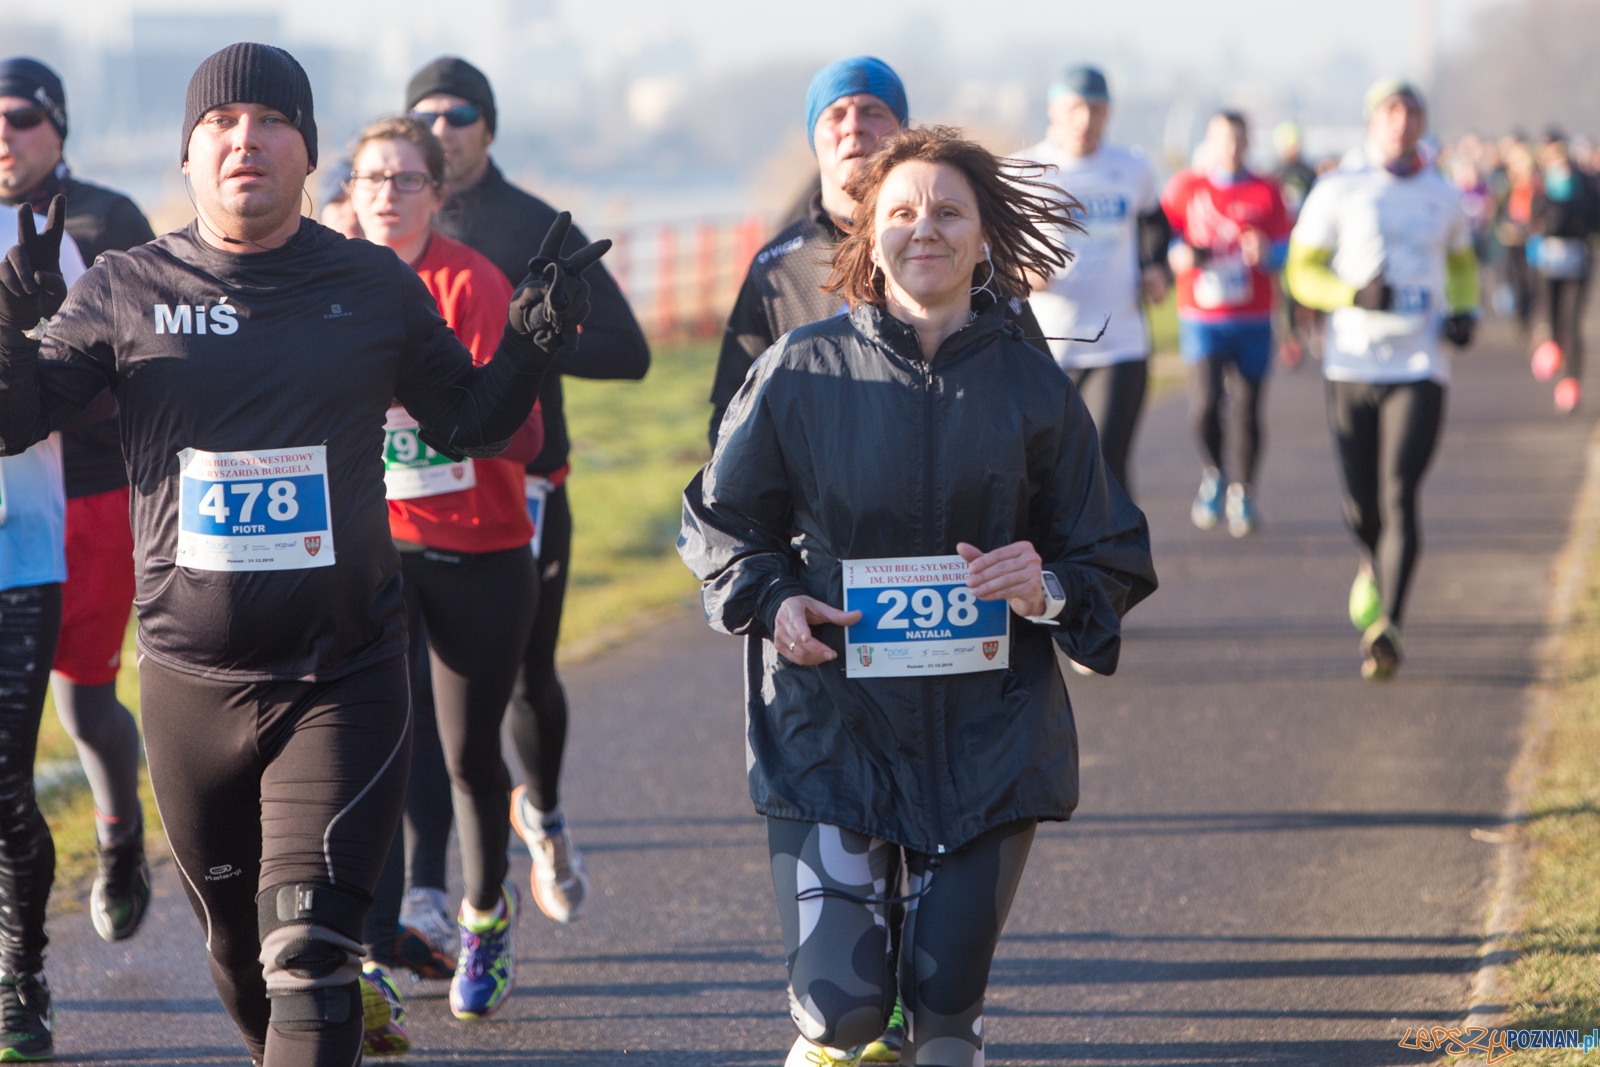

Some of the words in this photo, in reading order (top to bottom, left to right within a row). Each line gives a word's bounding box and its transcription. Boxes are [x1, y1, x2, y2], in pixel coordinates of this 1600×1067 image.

[153, 296, 239, 336] MiŚ
[213, 458, 237, 468] BIEG
[240, 453, 314, 465] SYLWESTROWY
[207, 468, 260, 478] RYSZARDA
[262, 464, 311, 476] BURGIELA
[198, 480, 299, 524] 478
[232, 524, 266, 534] PIOTR
[865, 565, 893, 574] XXXII
[895, 564, 919, 573] BIEG
[870, 576, 885, 584] IM.
[887, 574, 940, 584] RYSZARDA
[876, 586, 979, 630] 298
[905, 629, 952, 640] NATALIA
[205, 868, 242, 881] Kalenji
